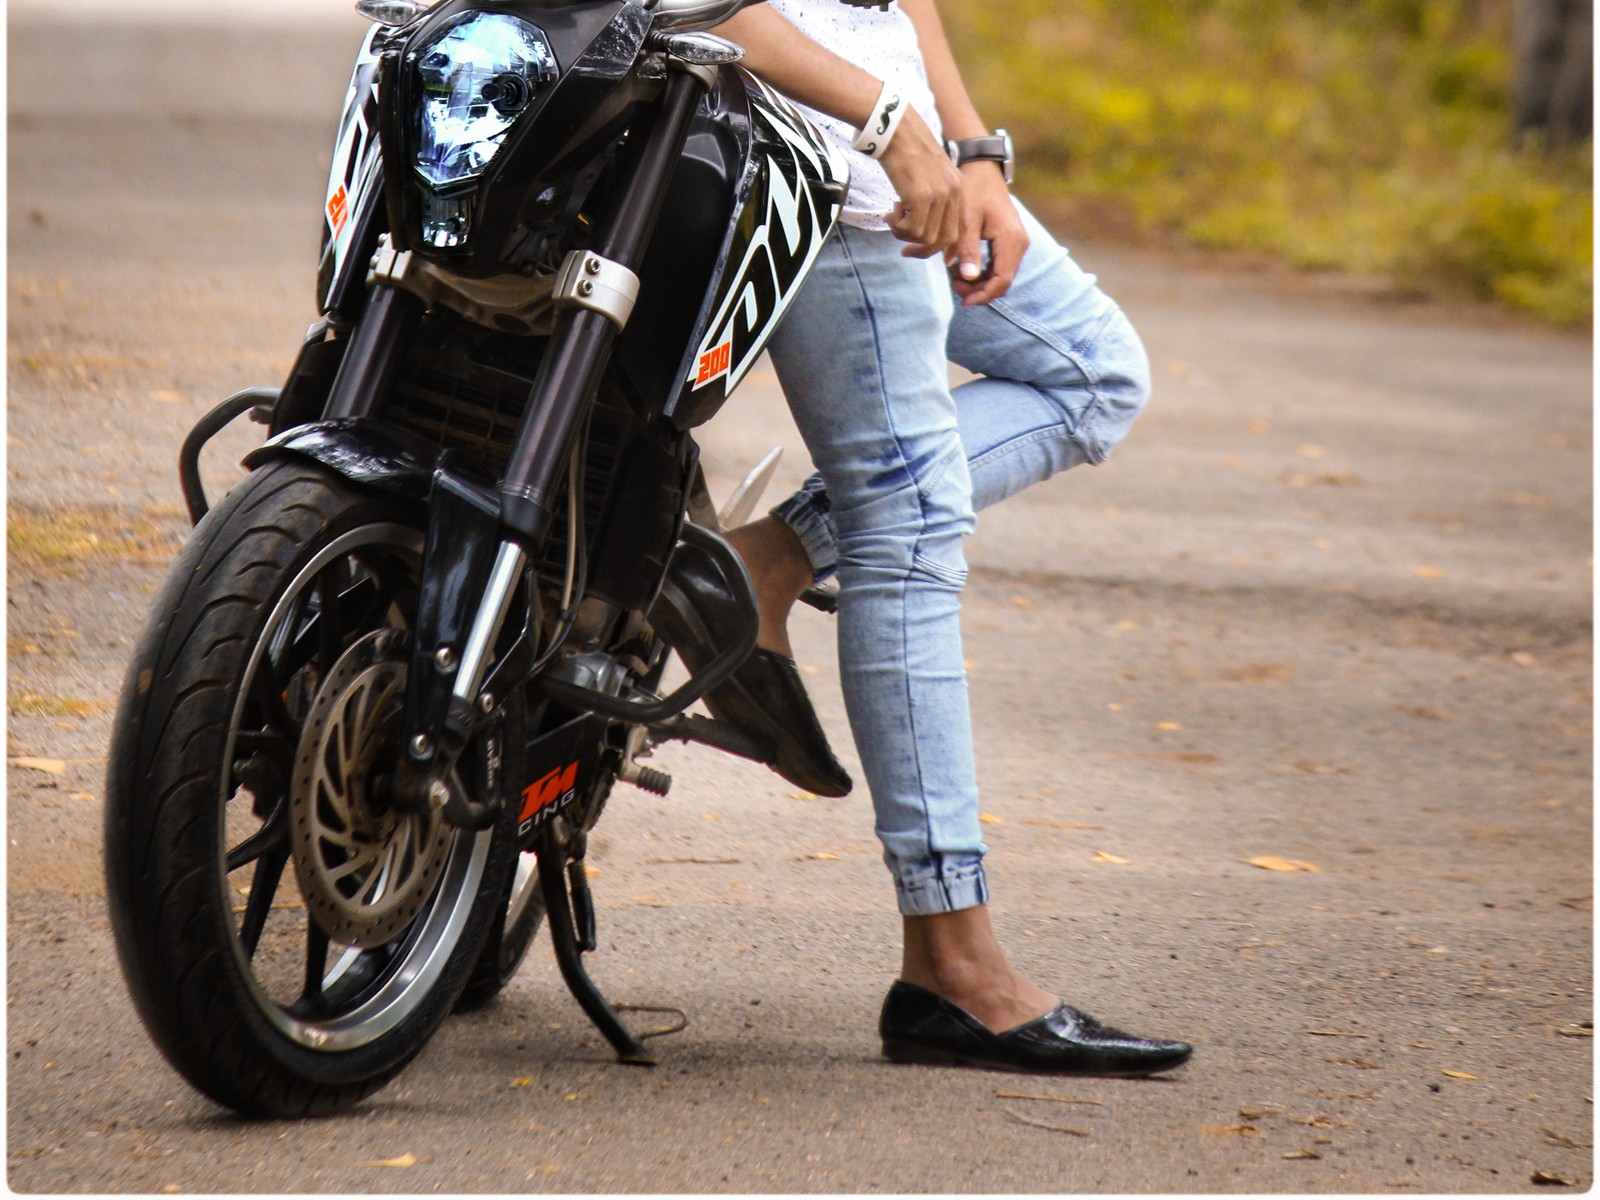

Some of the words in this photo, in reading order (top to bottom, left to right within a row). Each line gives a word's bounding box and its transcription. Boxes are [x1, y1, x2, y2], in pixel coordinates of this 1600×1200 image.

[695, 341, 731, 385] 200
[518, 760, 579, 824] TM
[518, 788, 575, 836] CING
